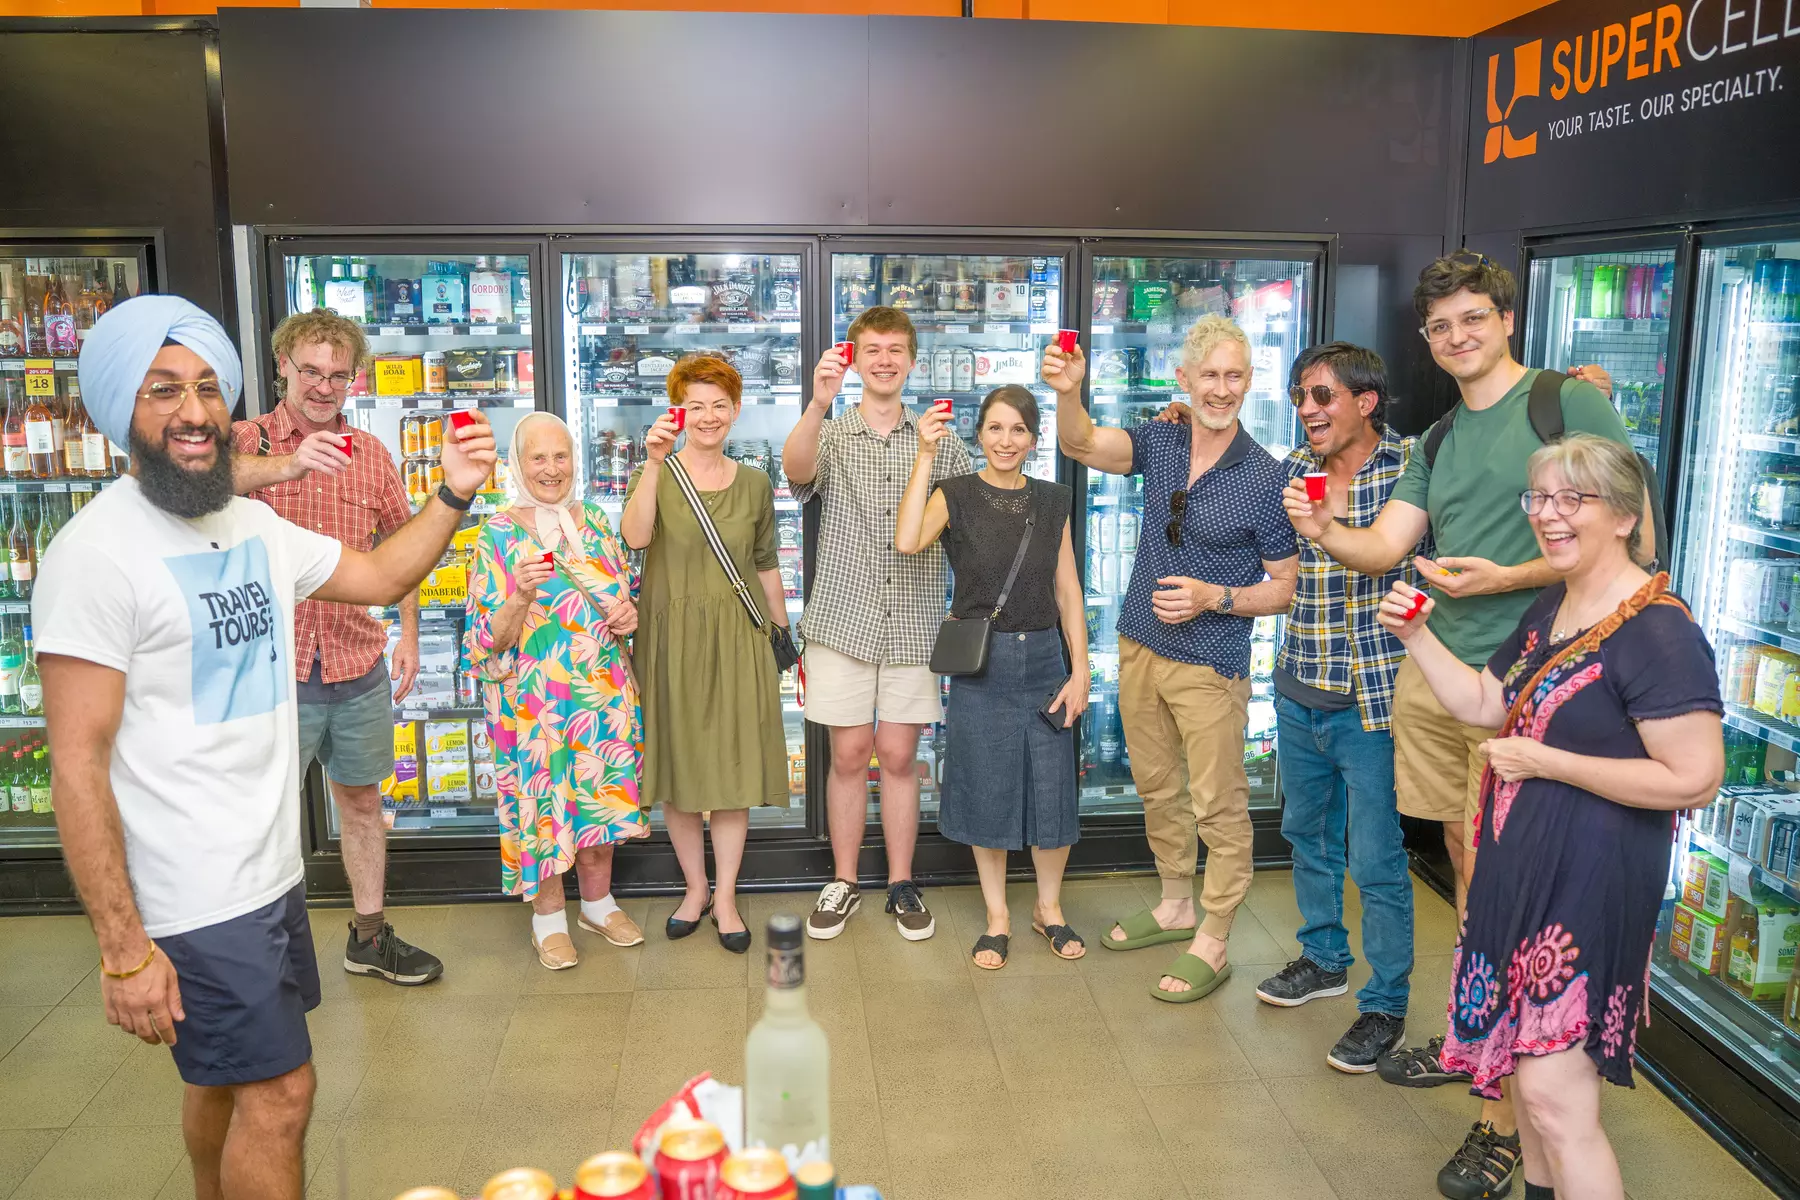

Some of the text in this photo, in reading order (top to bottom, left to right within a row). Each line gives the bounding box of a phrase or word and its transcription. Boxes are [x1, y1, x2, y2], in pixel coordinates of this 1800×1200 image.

[1548, 66, 1784, 140] YOUR TASTE. OUR SPECIALTY.
[472, 283, 509, 294] GORDON'S
[1015, 285, 1025, 294] 10
[1094, 286, 1119, 294] JAMSON
[993, 359, 1008, 373] JIM
[29, 378, 49, 389] $18
[421, 585, 465, 597] NDABERG
[199, 580, 270, 620] TRAVEL
[209, 607, 269, 649] TOURS
